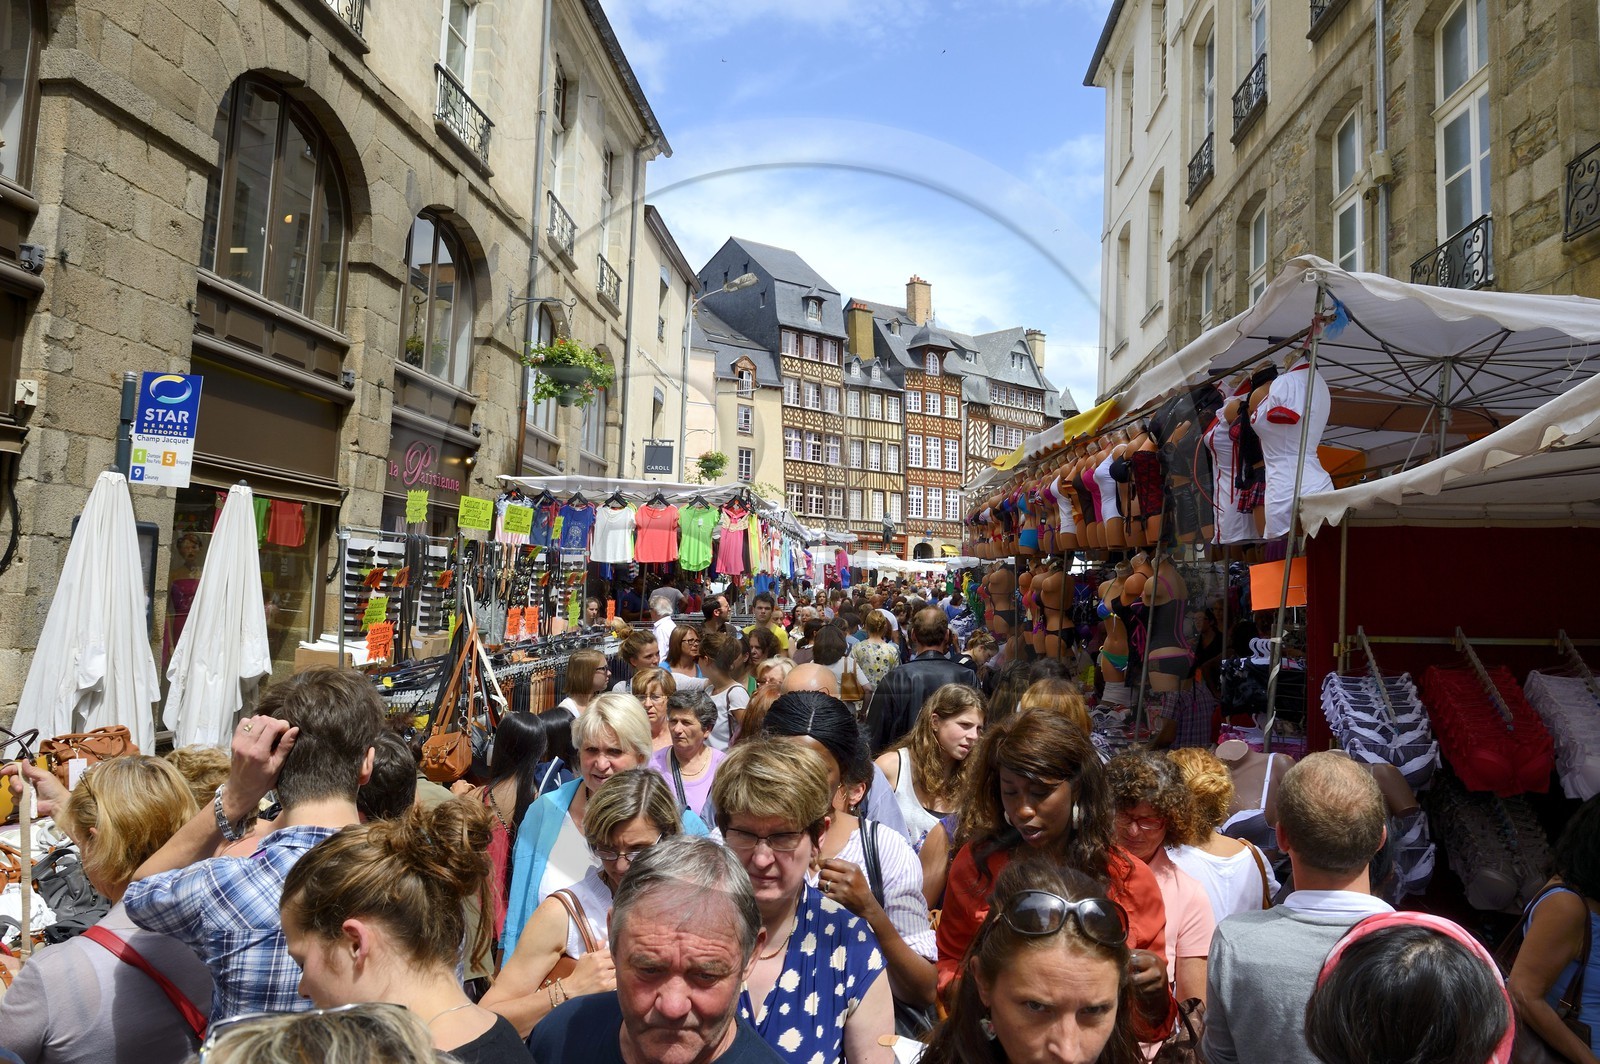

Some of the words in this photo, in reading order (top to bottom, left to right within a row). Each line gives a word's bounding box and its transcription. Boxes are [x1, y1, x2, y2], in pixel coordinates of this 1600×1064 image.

[144, 408, 189, 424] STAR
[143, 422, 188, 431] RENNES
[137, 434, 160, 443] Champ
[162, 436, 189, 445] Jacquet
[165, 453, 173, 464] 5
[388, 460, 399, 477] la
[402, 440, 460, 492] Parisienne
[134, 468, 142, 478] 9
